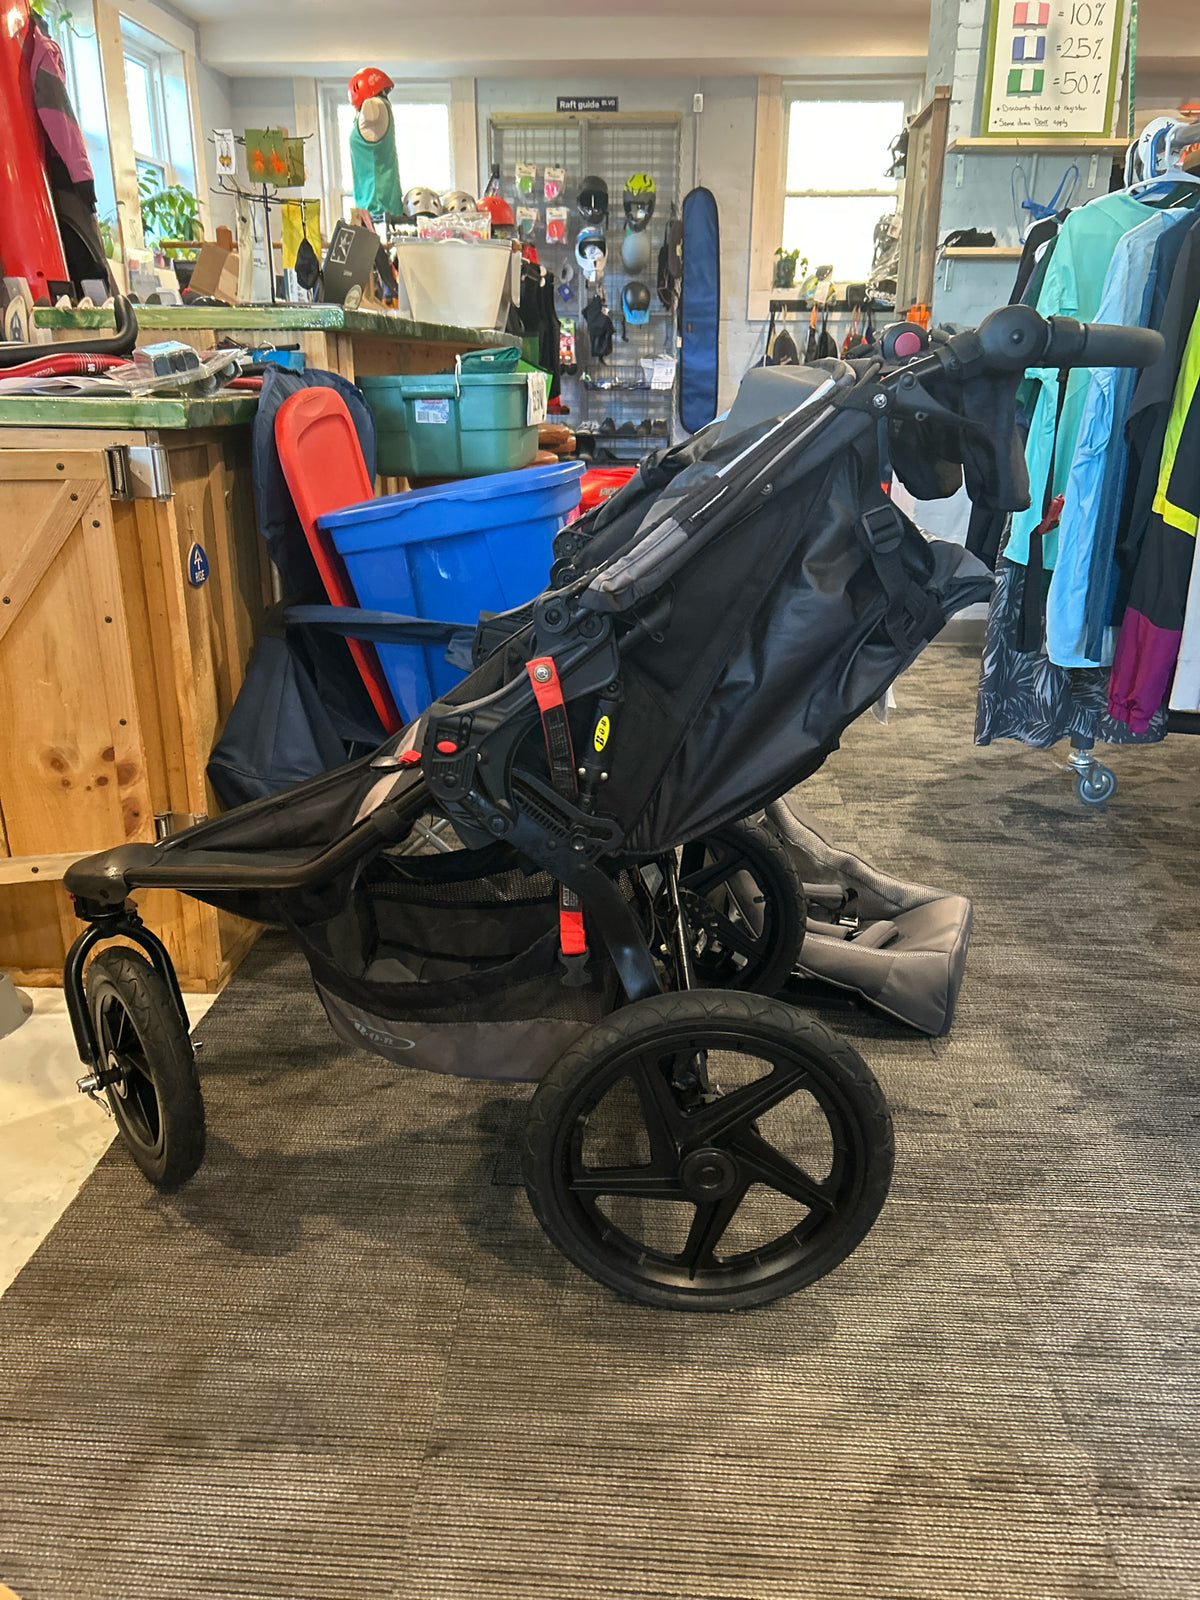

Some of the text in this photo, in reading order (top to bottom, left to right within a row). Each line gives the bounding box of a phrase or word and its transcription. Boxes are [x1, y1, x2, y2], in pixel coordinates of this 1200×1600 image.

[559, 100, 577, 109] Raft
[577, 100, 600, 110] guide
[1033, 103, 1051, 111] taken
[1064, 104, 1087, 113] register
[999, 118, 1014, 127] Some
[1053, 118, 1068, 127] apply
